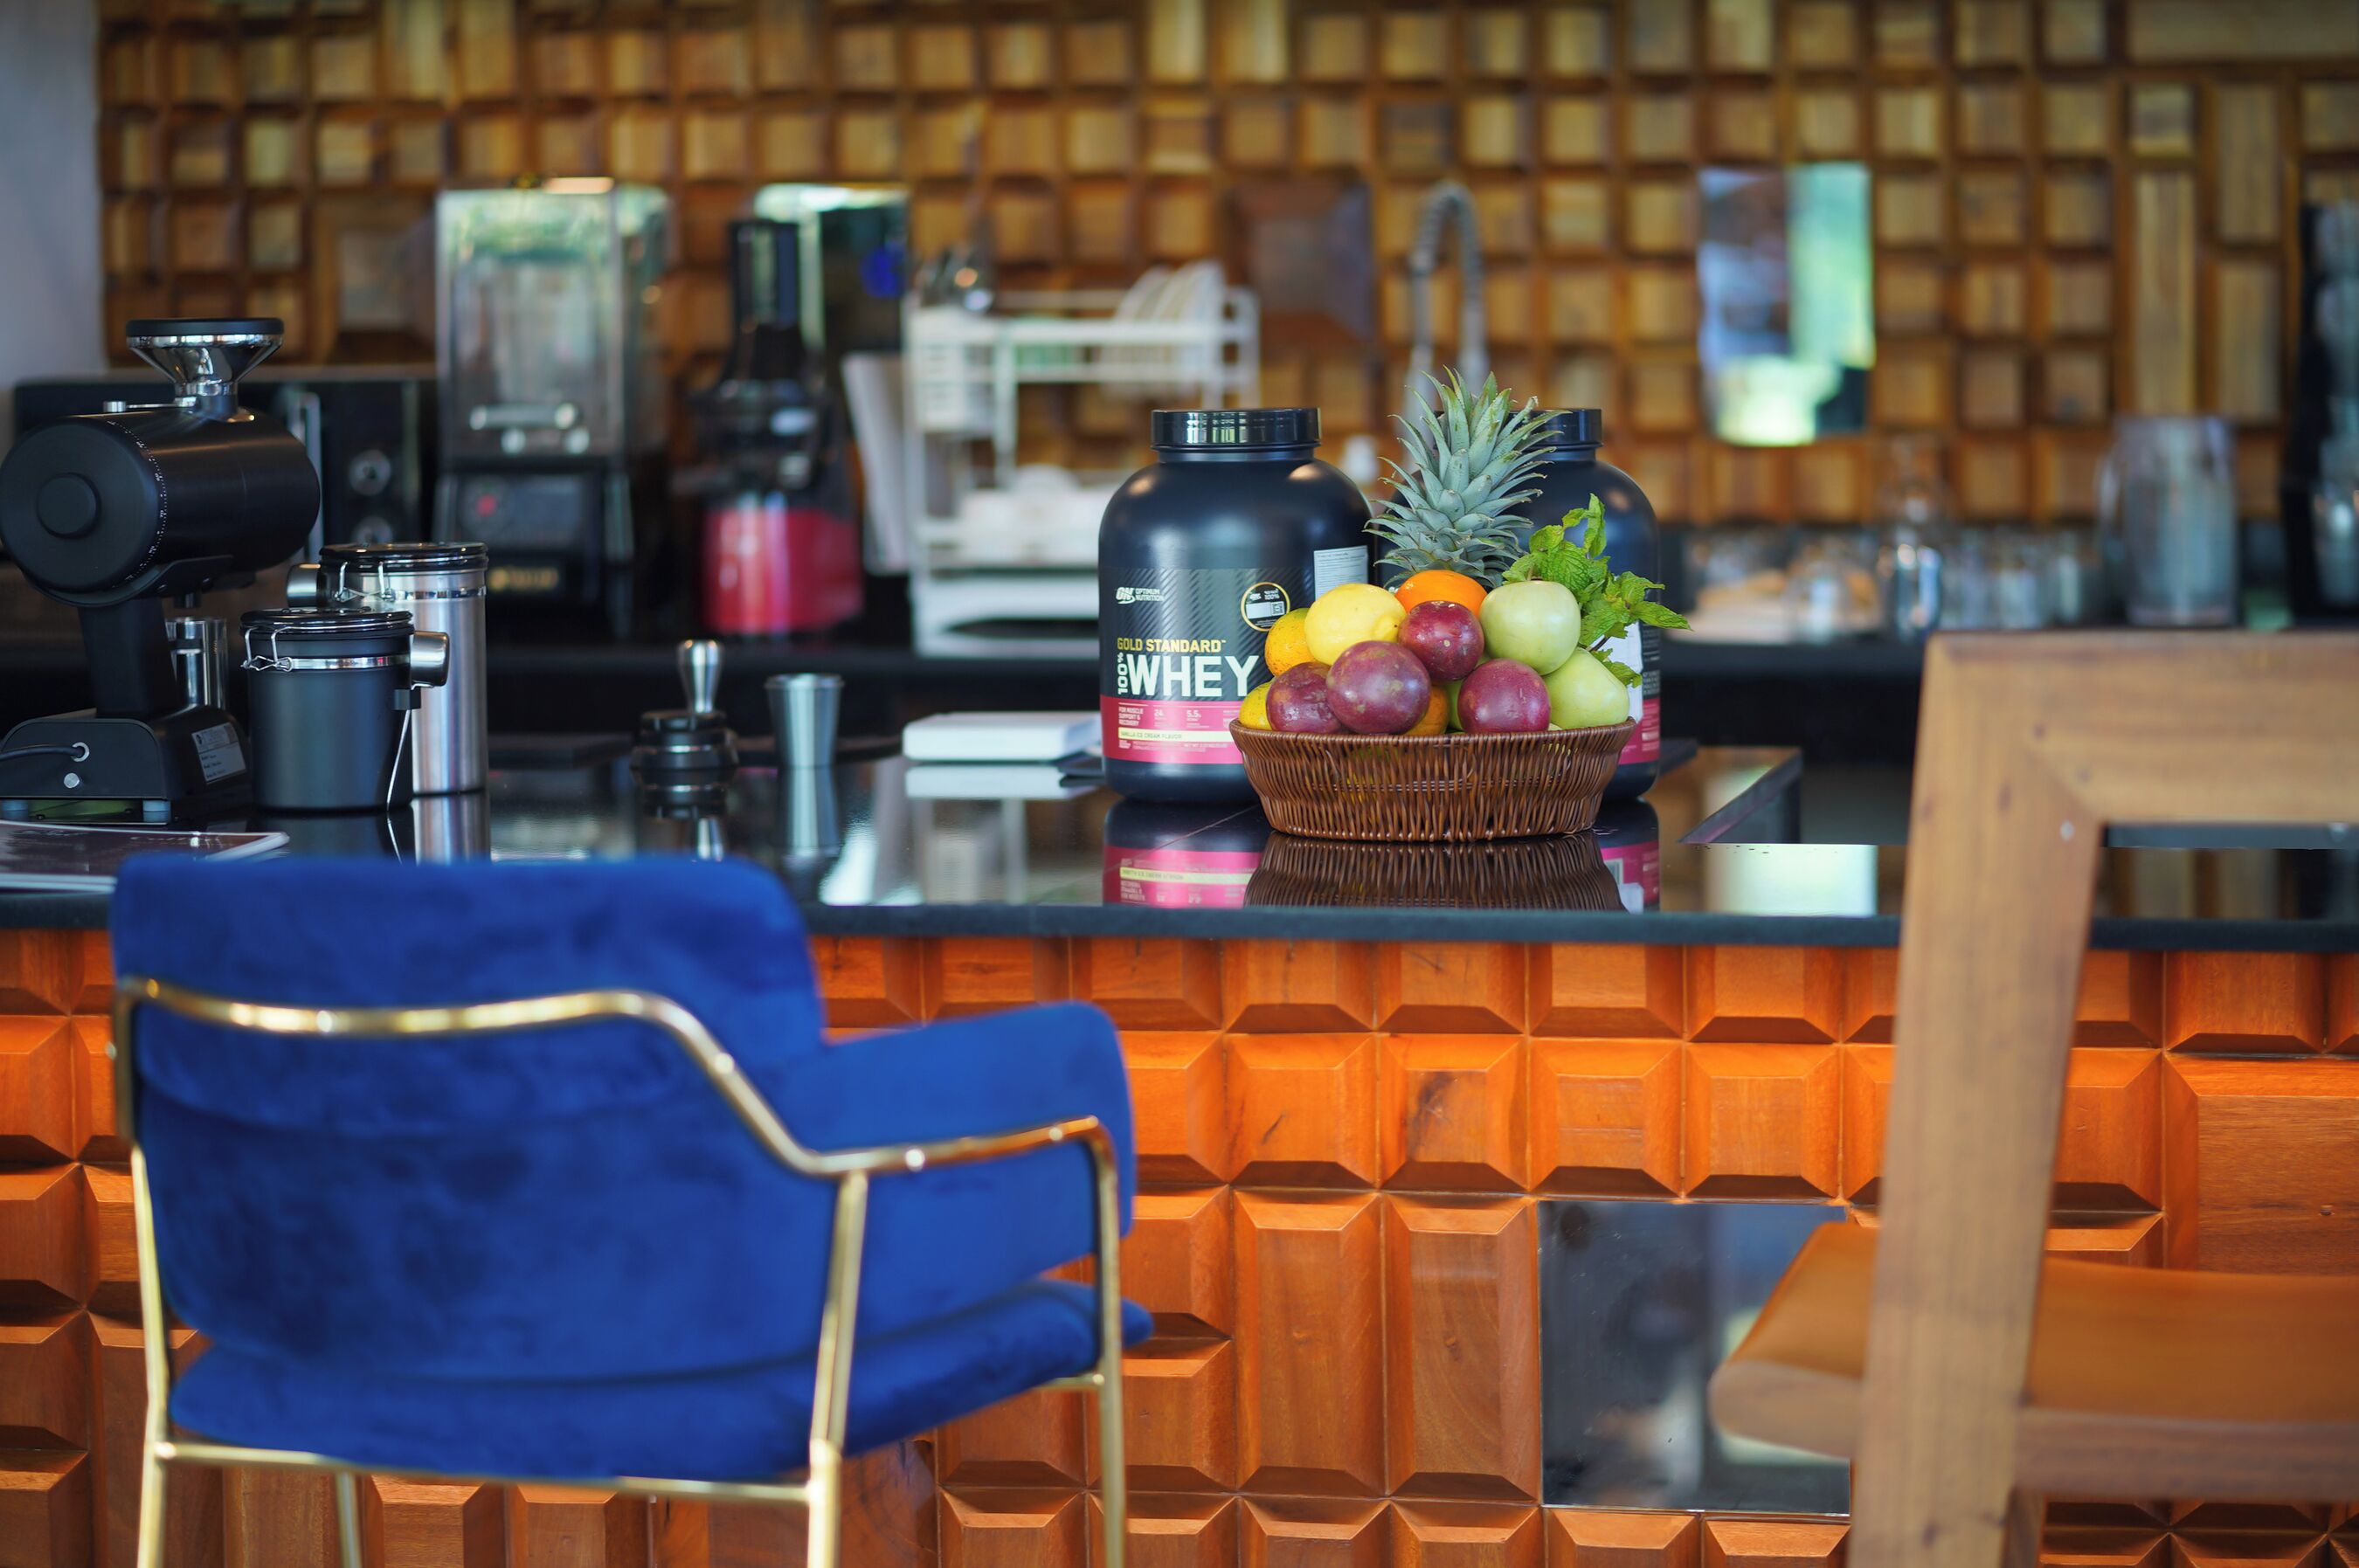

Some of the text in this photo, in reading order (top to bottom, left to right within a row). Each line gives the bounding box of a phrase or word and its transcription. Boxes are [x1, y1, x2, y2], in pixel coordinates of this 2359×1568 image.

[1117, 638, 1143, 651] GOLD
[1117, 653, 1129, 694] 100%
[1126, 654, 1259, 697] WHEY
